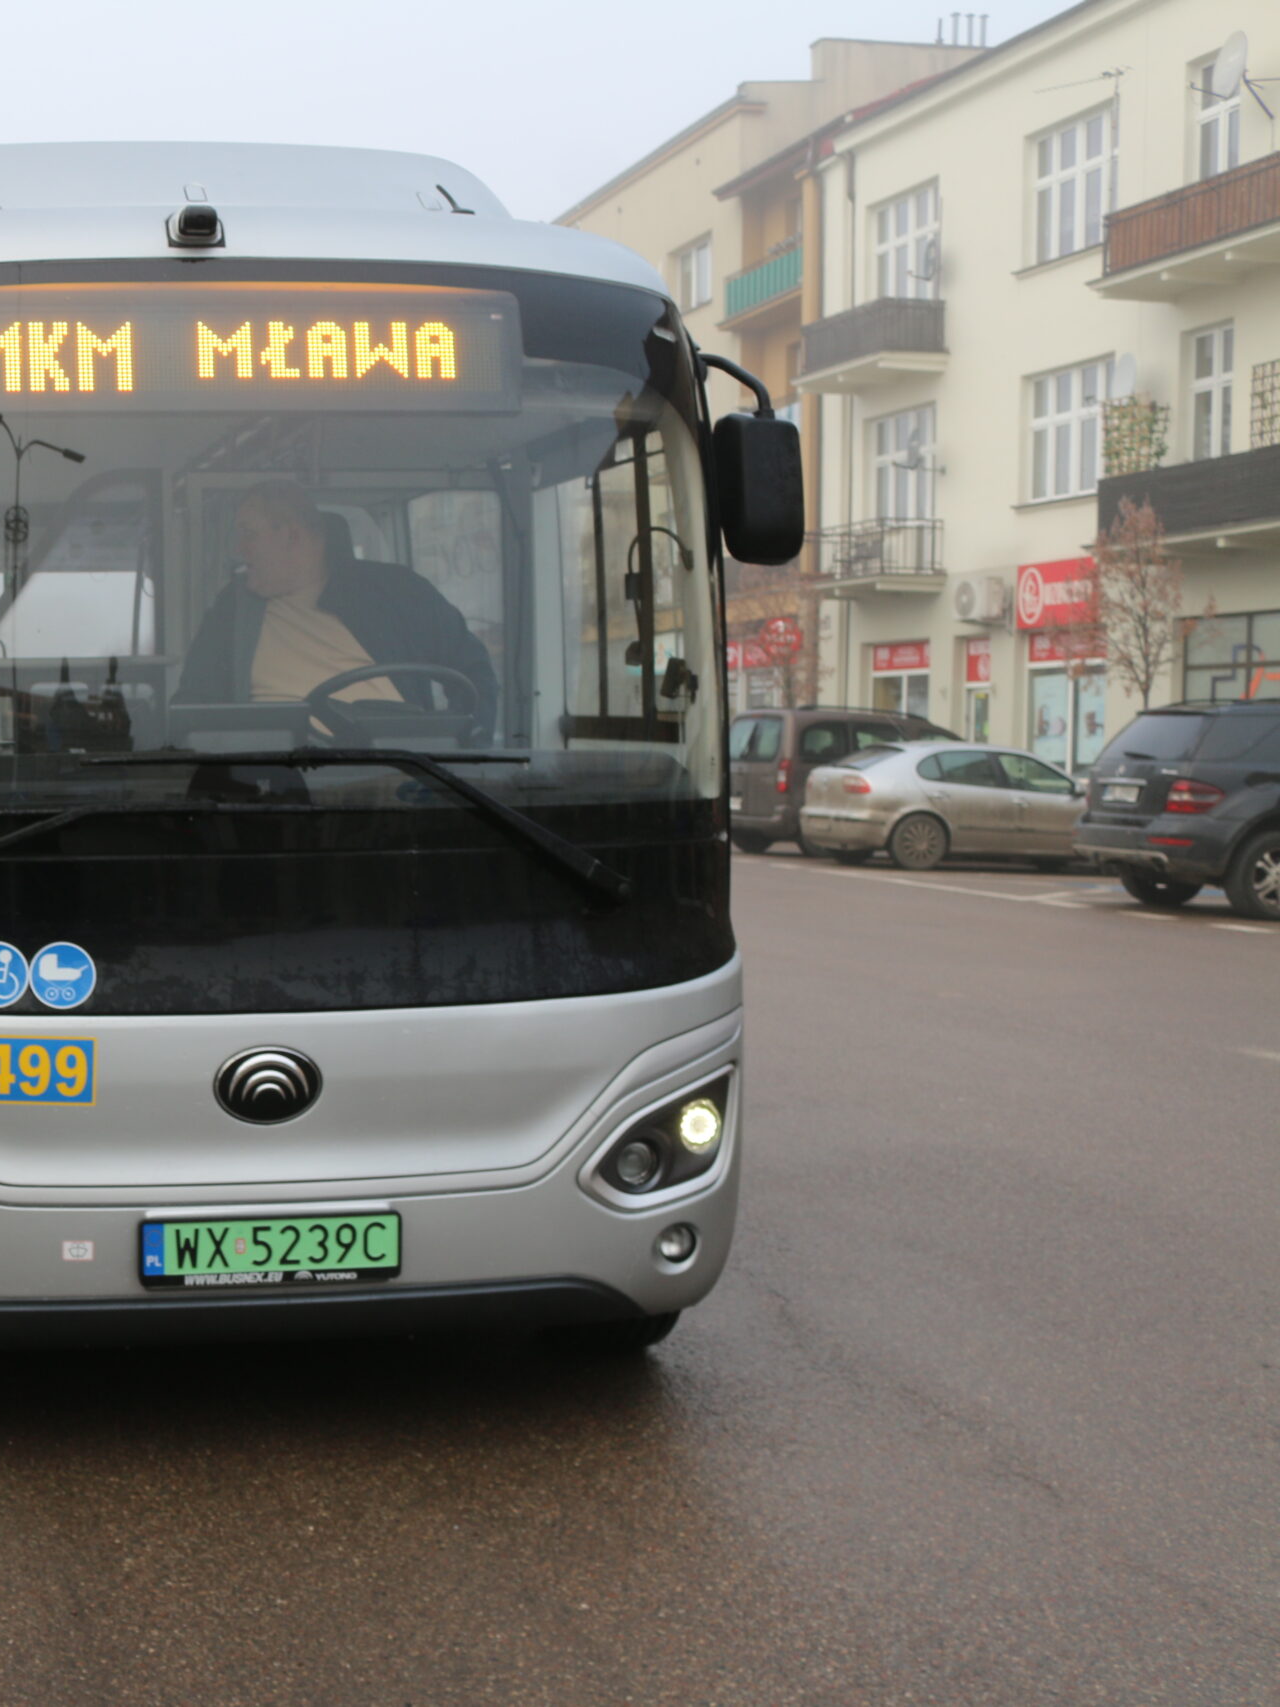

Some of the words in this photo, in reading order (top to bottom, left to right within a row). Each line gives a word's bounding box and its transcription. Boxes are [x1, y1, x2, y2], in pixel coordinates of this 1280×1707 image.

[196, 320, 457, 380] MŁAWA
[146, 1255, 162, 1267] PL
[175, 1227, 230, 1269] WX
[251, 1222, 387, 1267] 5239C
